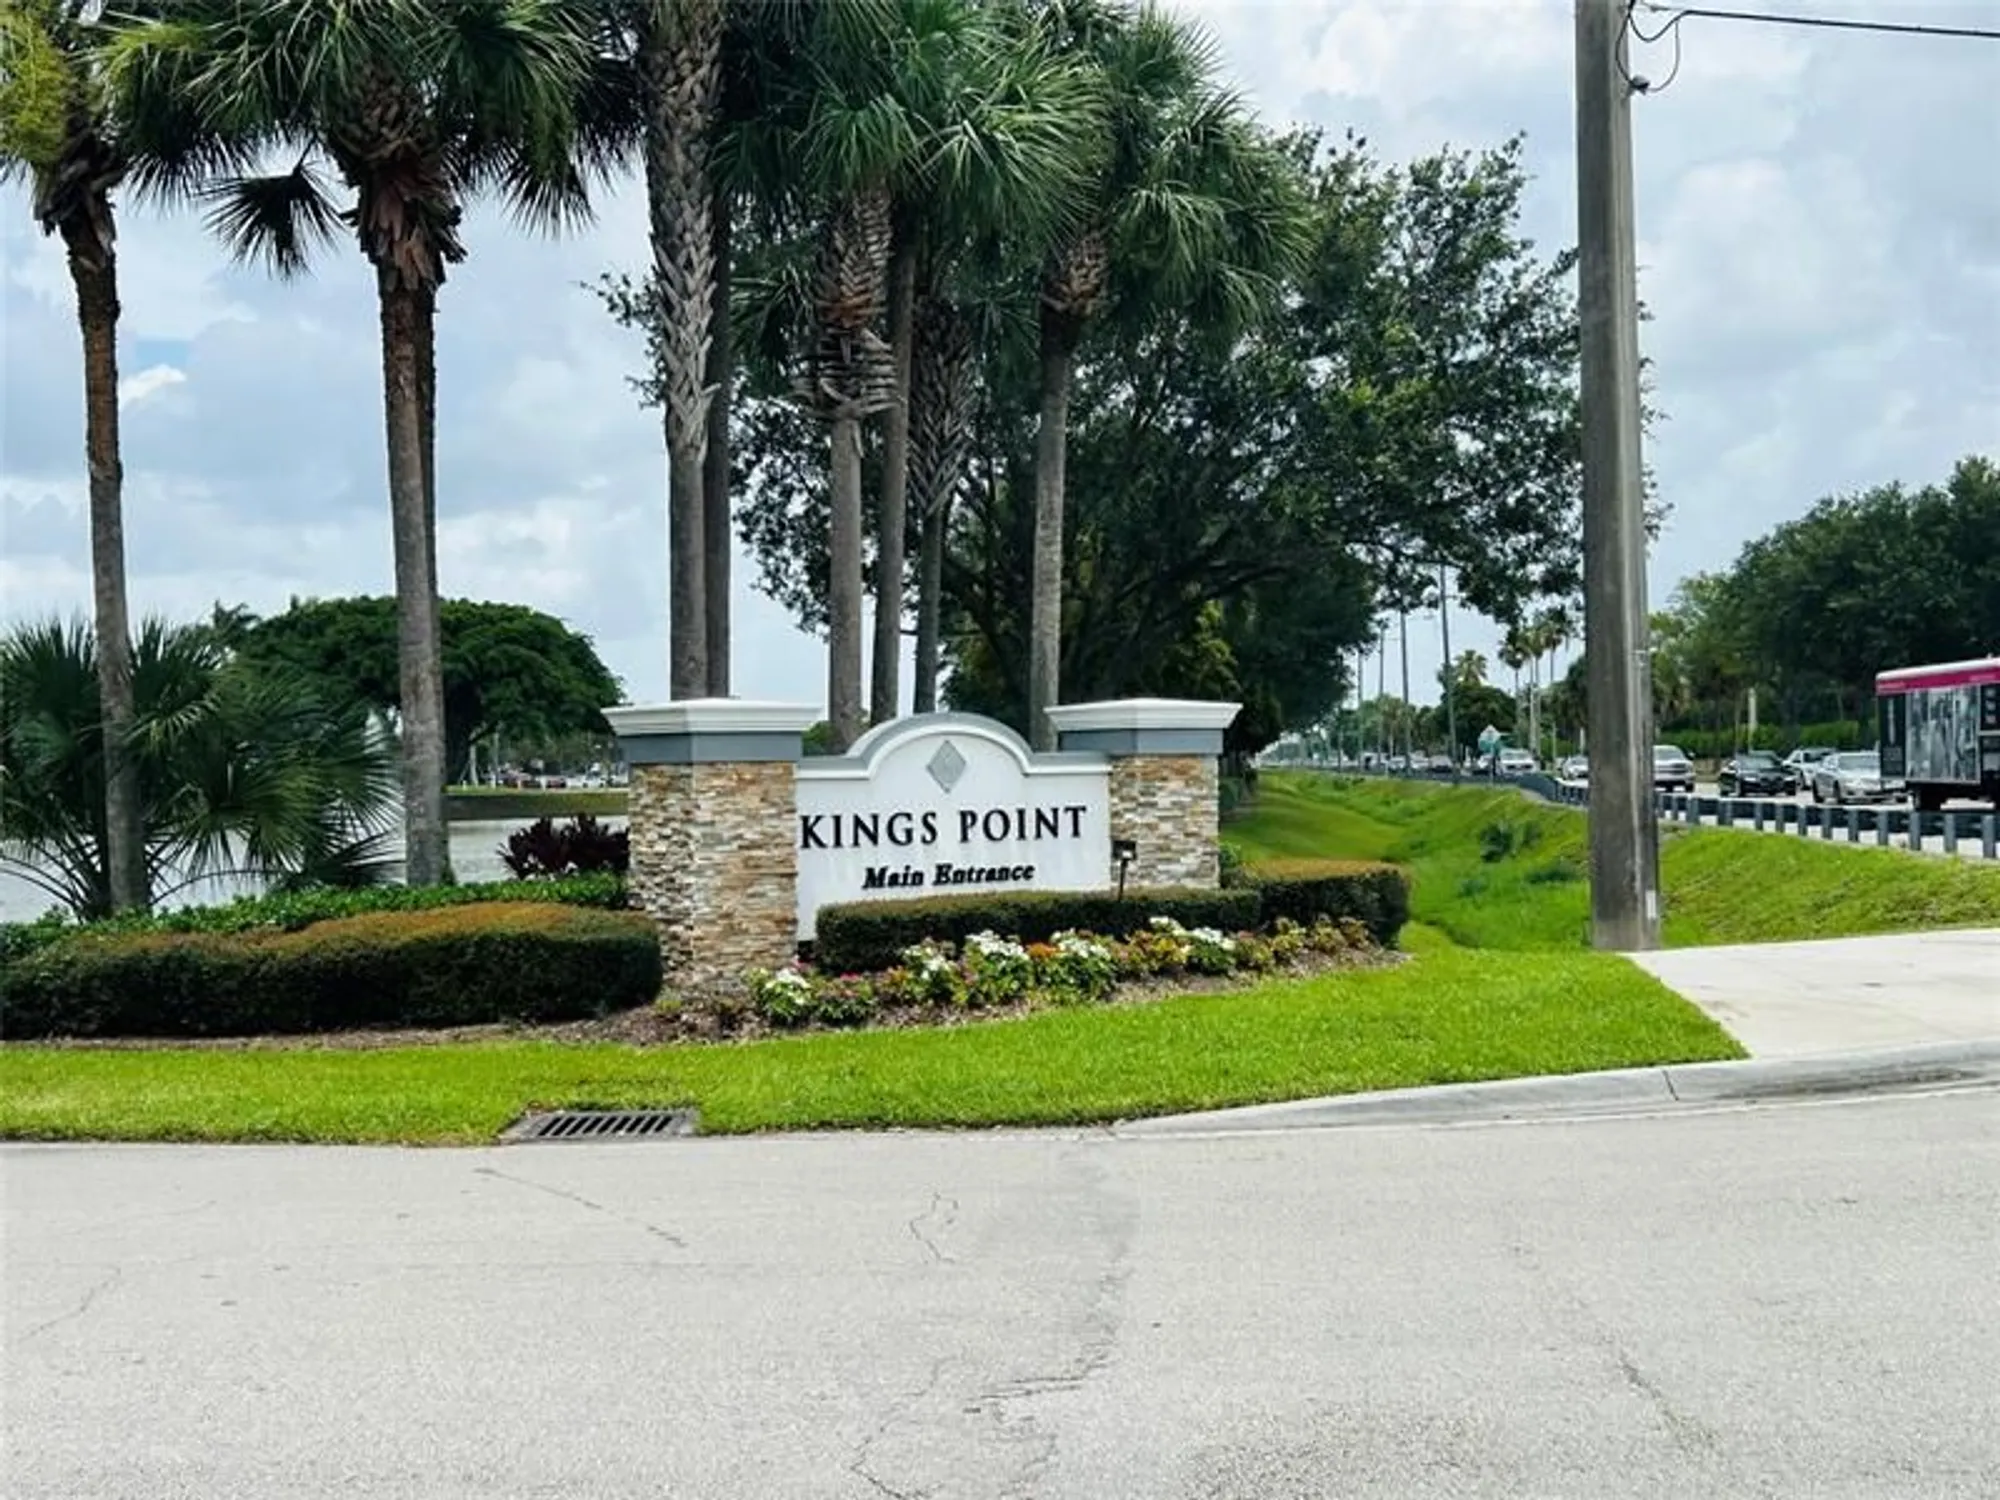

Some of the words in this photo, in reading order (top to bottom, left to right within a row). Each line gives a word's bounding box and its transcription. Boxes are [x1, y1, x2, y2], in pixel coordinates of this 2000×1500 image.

[801, 812, 937, 849] KINGS
[960, 806, 1086, 843] POINT
[862, 865, 924, 889] Main
[933, 864, 1034, 886] Entrance
